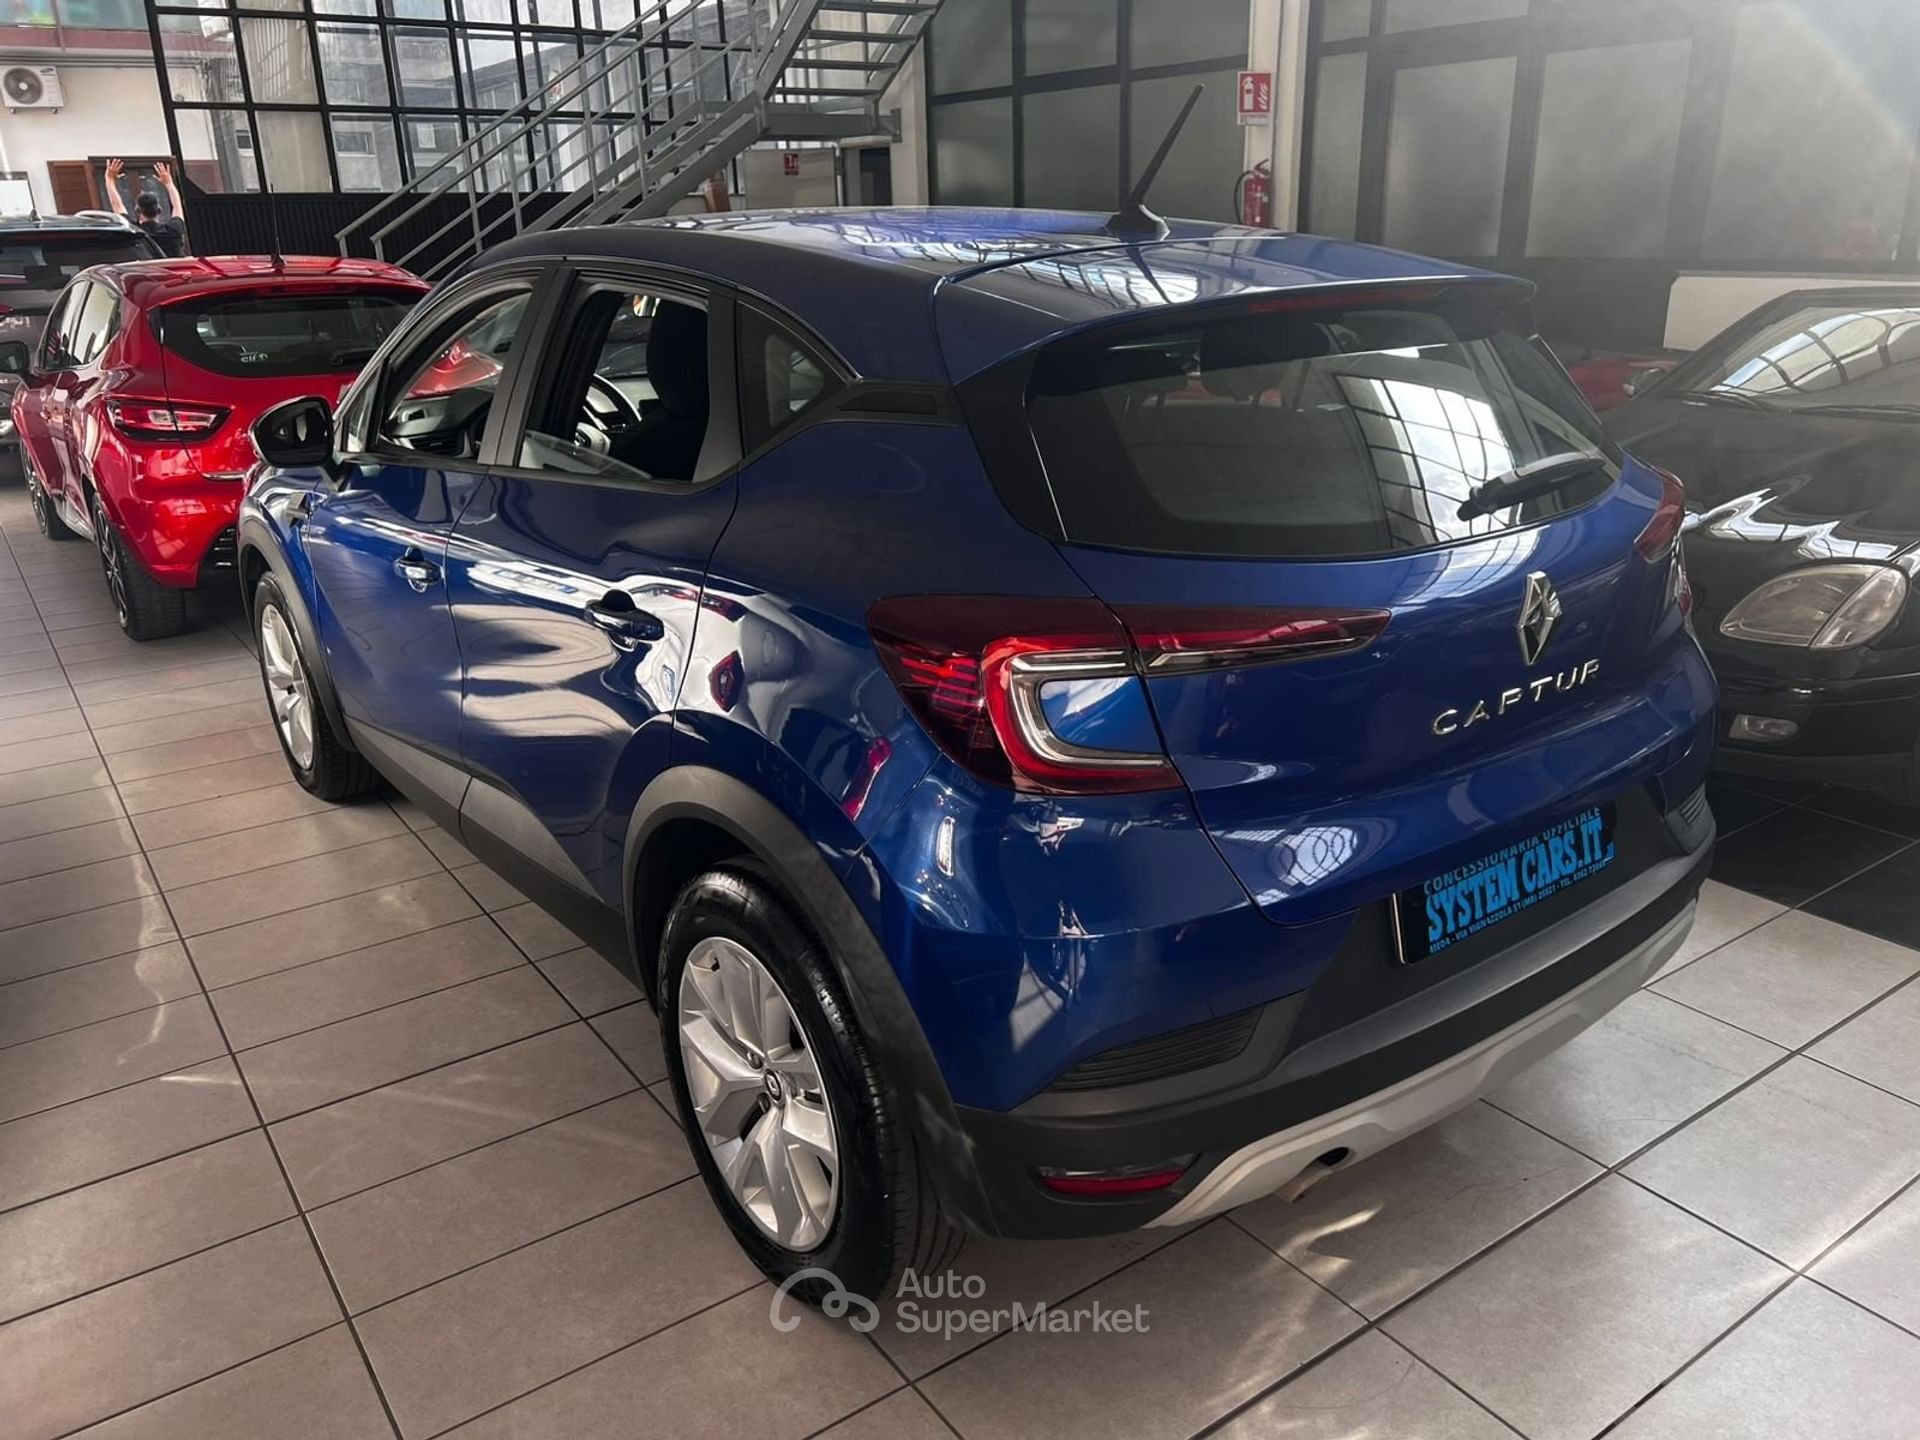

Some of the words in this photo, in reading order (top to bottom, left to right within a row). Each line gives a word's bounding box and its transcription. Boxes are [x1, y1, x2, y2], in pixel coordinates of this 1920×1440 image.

[1432, 658, 1600, 735] CAPTUR
[1423, 834, 1538, 895] CONCESSIONARIA
[1543, 807, 1601, 842] UFFICIALE
[1425, 856, 1520, 943] SYSTEM
[1521, 816, 1604, 893] CARS.IT
